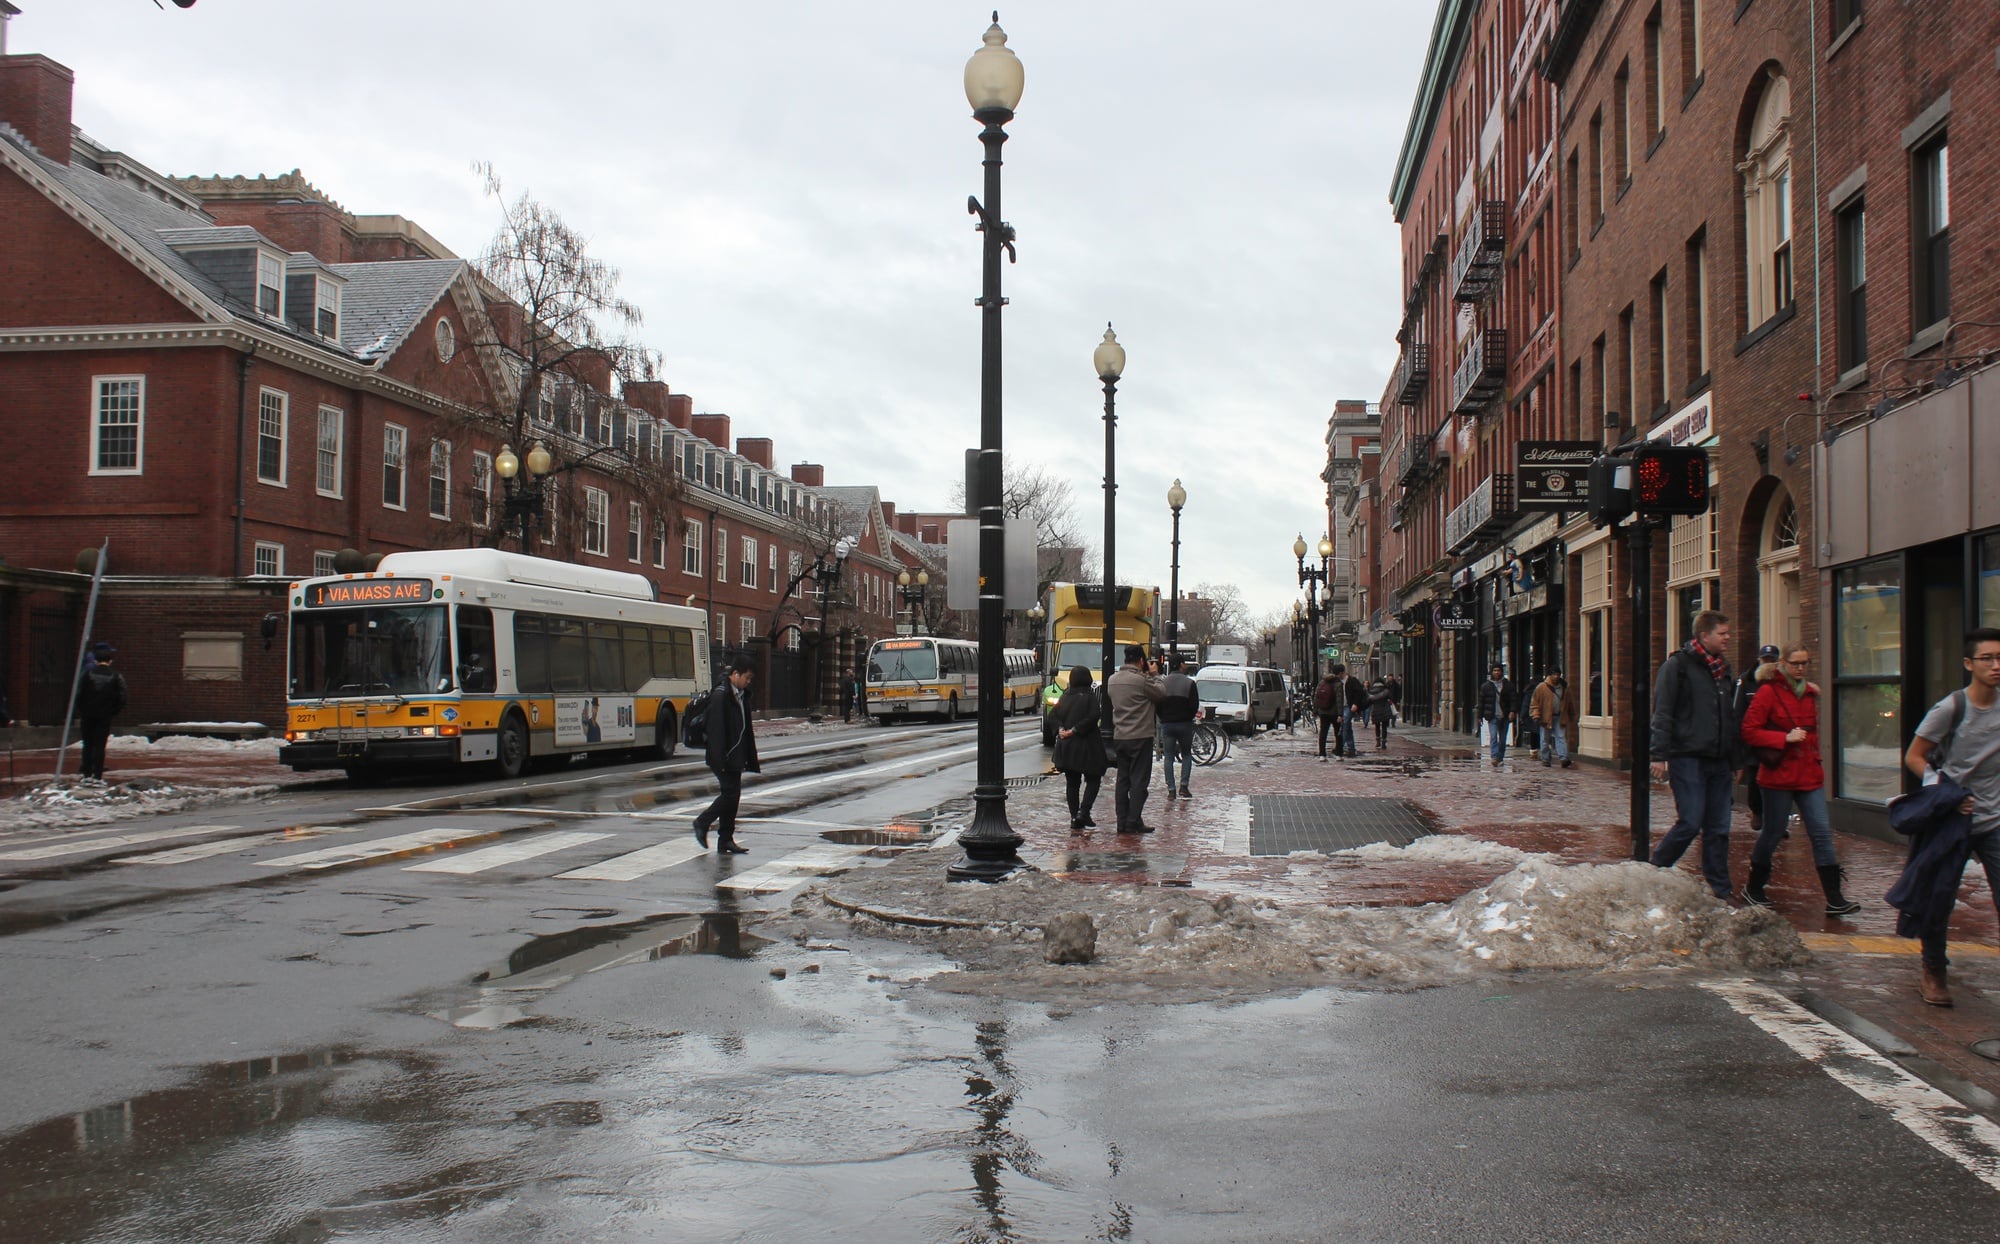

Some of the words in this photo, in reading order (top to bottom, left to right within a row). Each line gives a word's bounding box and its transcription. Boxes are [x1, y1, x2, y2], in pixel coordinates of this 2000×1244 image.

[1691, 405, 1707, 435] SHOP
[1538, 449, 1593, 460] August
[1541, 469, 1570, 477] HARVARD
[1525, 480, 1537, 488] THE
[317, 587, 324, 605] 1
[329, 586, 350, 601] VIA
[353, 585, 391, 600] MASS
[395, 583, 421, 599] AVE
[297, 714, 316, 723] 2271
